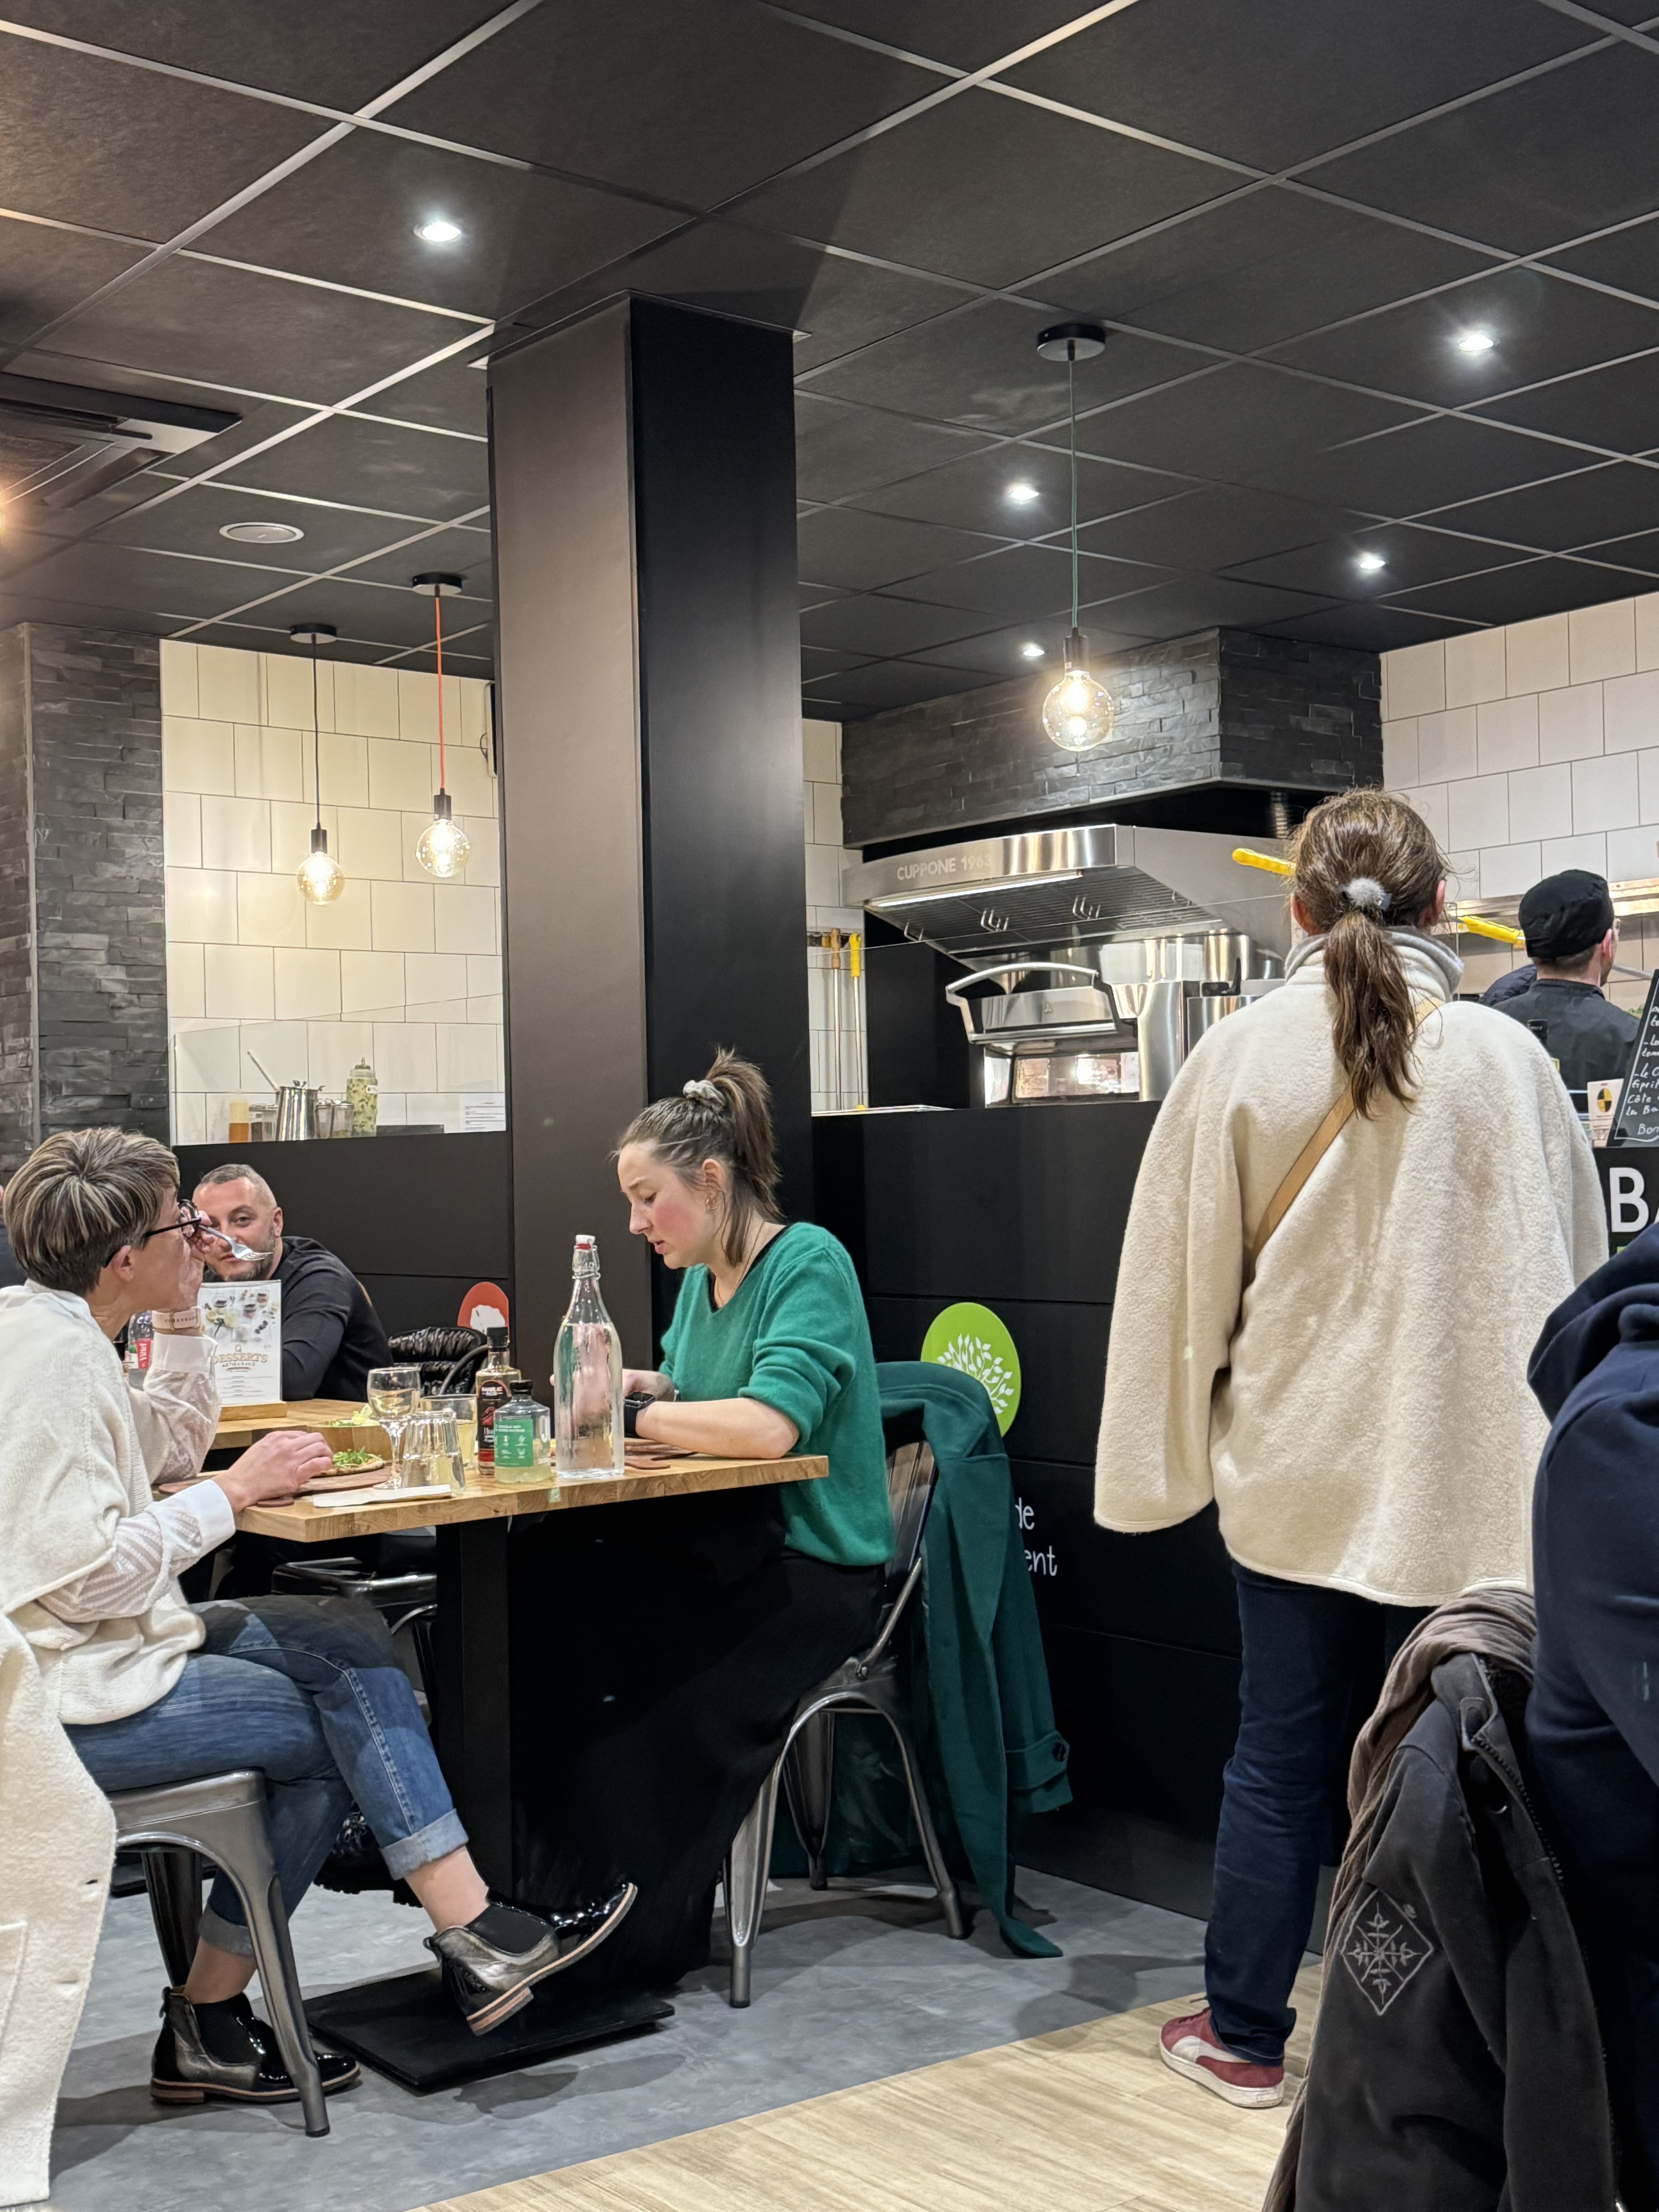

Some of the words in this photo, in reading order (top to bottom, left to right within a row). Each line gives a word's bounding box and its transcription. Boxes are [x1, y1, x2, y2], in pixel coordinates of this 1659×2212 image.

[897, 857, 956, 880] CUPPONE
[960, 854, 992, 871] 1963
[1609, 1167, 1659, 1232] B
